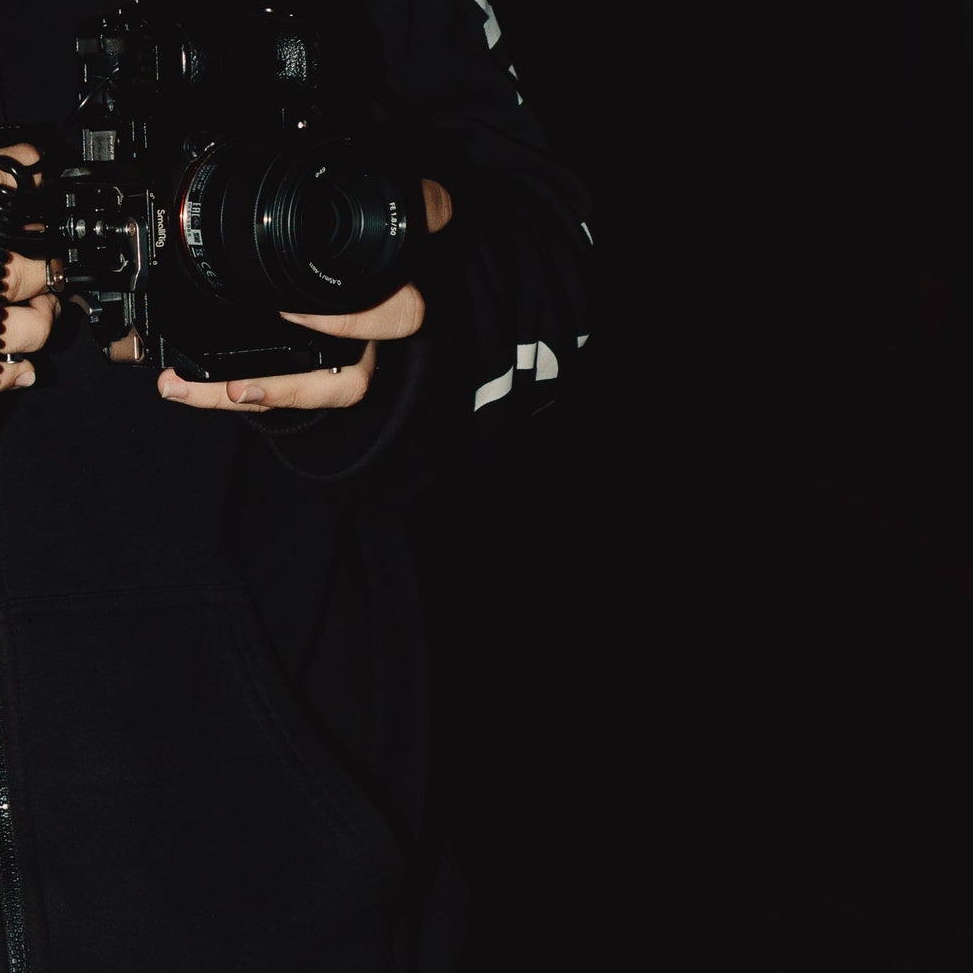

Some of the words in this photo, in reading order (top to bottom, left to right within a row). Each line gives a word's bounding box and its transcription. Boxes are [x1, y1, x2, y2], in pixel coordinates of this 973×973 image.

[389, 201, 397, 211] FE
[155, 209, 167, 248] SmallRig
[390, 212, 398, 236] 1.8/50
